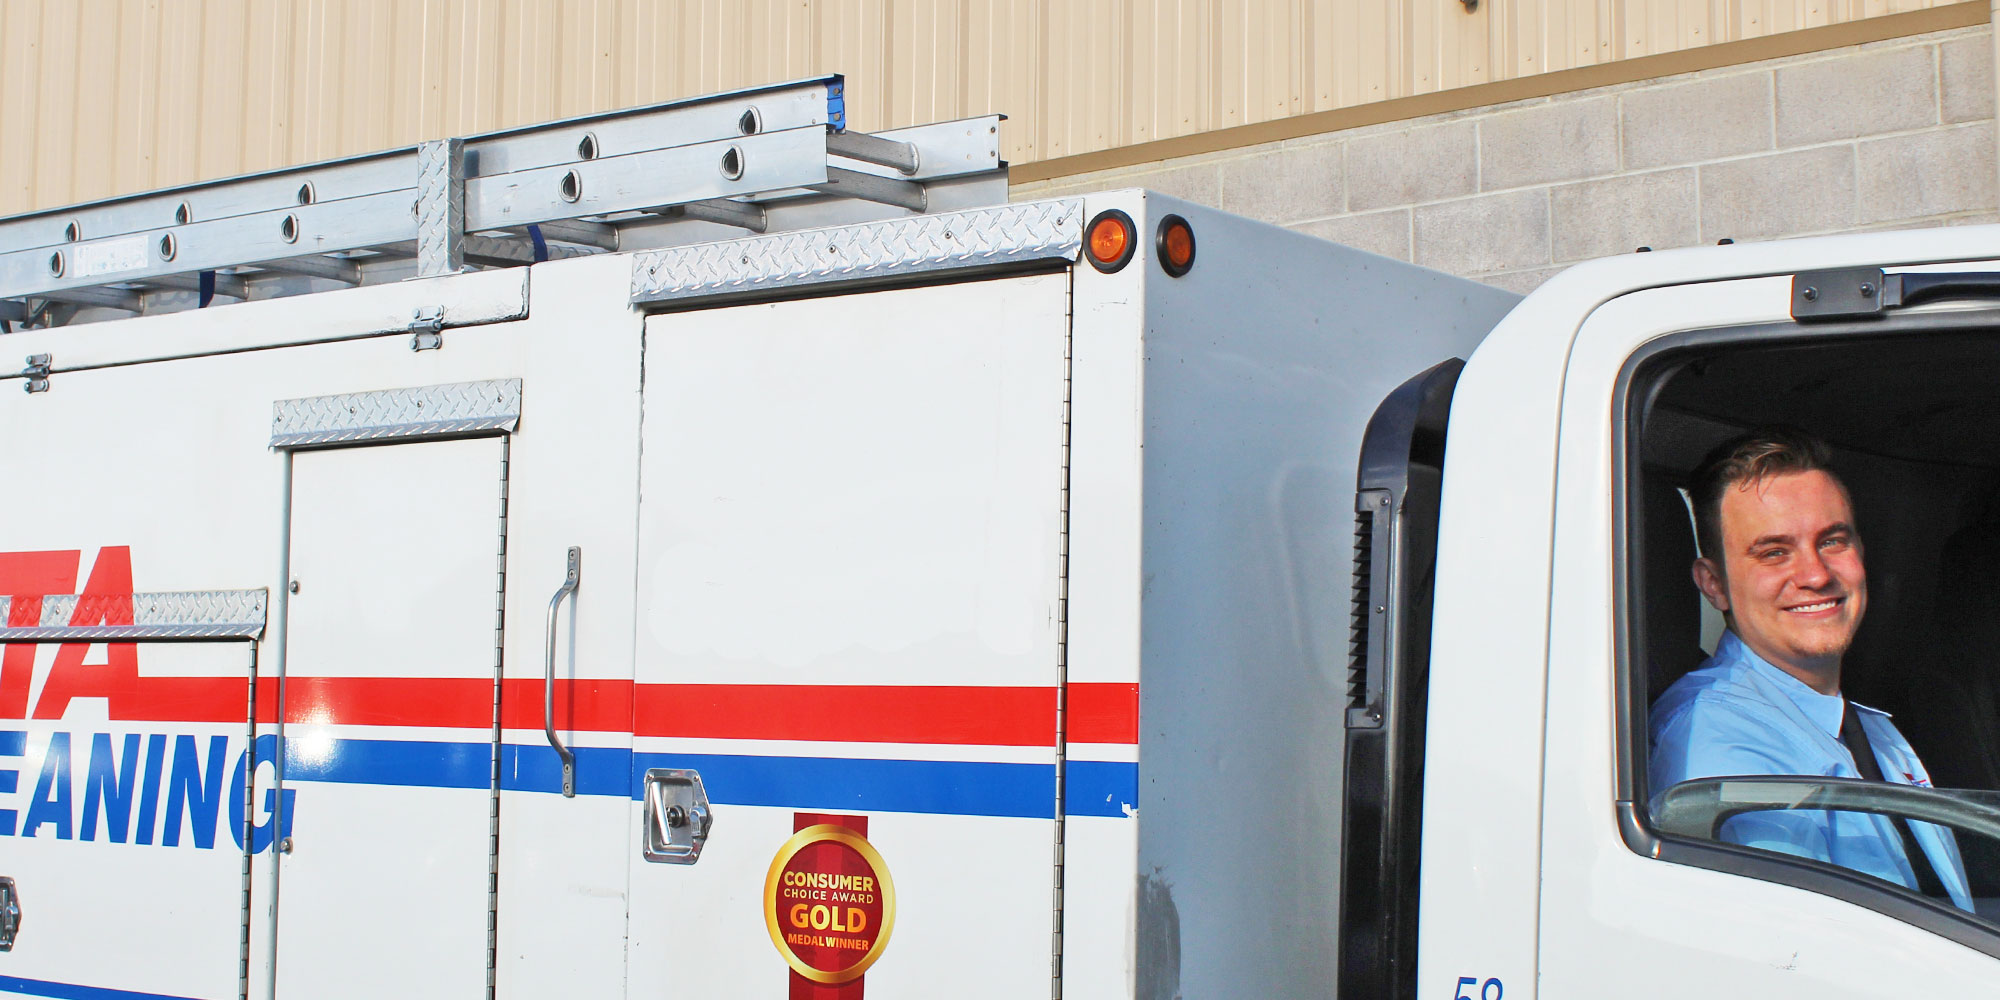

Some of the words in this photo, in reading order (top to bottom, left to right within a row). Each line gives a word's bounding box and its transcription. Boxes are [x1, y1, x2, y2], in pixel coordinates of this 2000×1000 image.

[784, 871, 874, 892] CONSUMER
[784, 888, 827, 900] CHOICE
[831, 891, 874, 904] AWARD
[790, 903, 867, 933] GOLD
